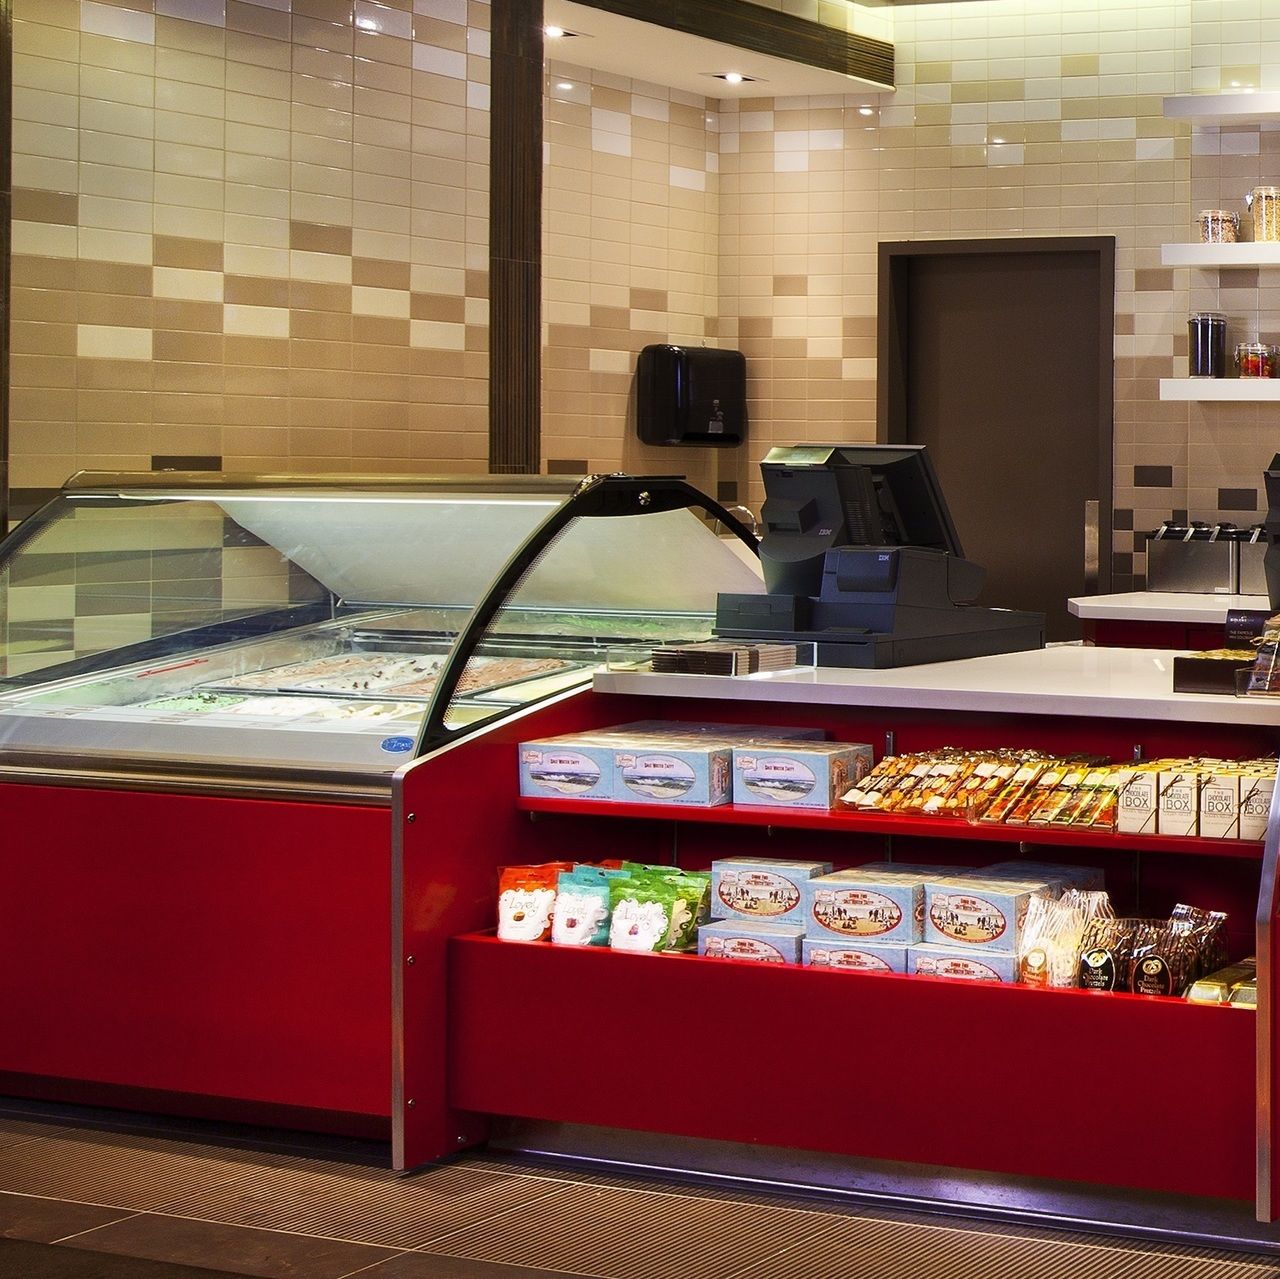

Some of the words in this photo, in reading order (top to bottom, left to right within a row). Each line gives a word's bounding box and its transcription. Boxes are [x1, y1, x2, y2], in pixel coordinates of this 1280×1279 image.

[1126, 796, 1149, 808] BOX
[1208, 794, 1231, 802] CHOCOLATE
[1167, 799, 1190, 811] BOX
[1208, 801, 1231, 812] BOX
